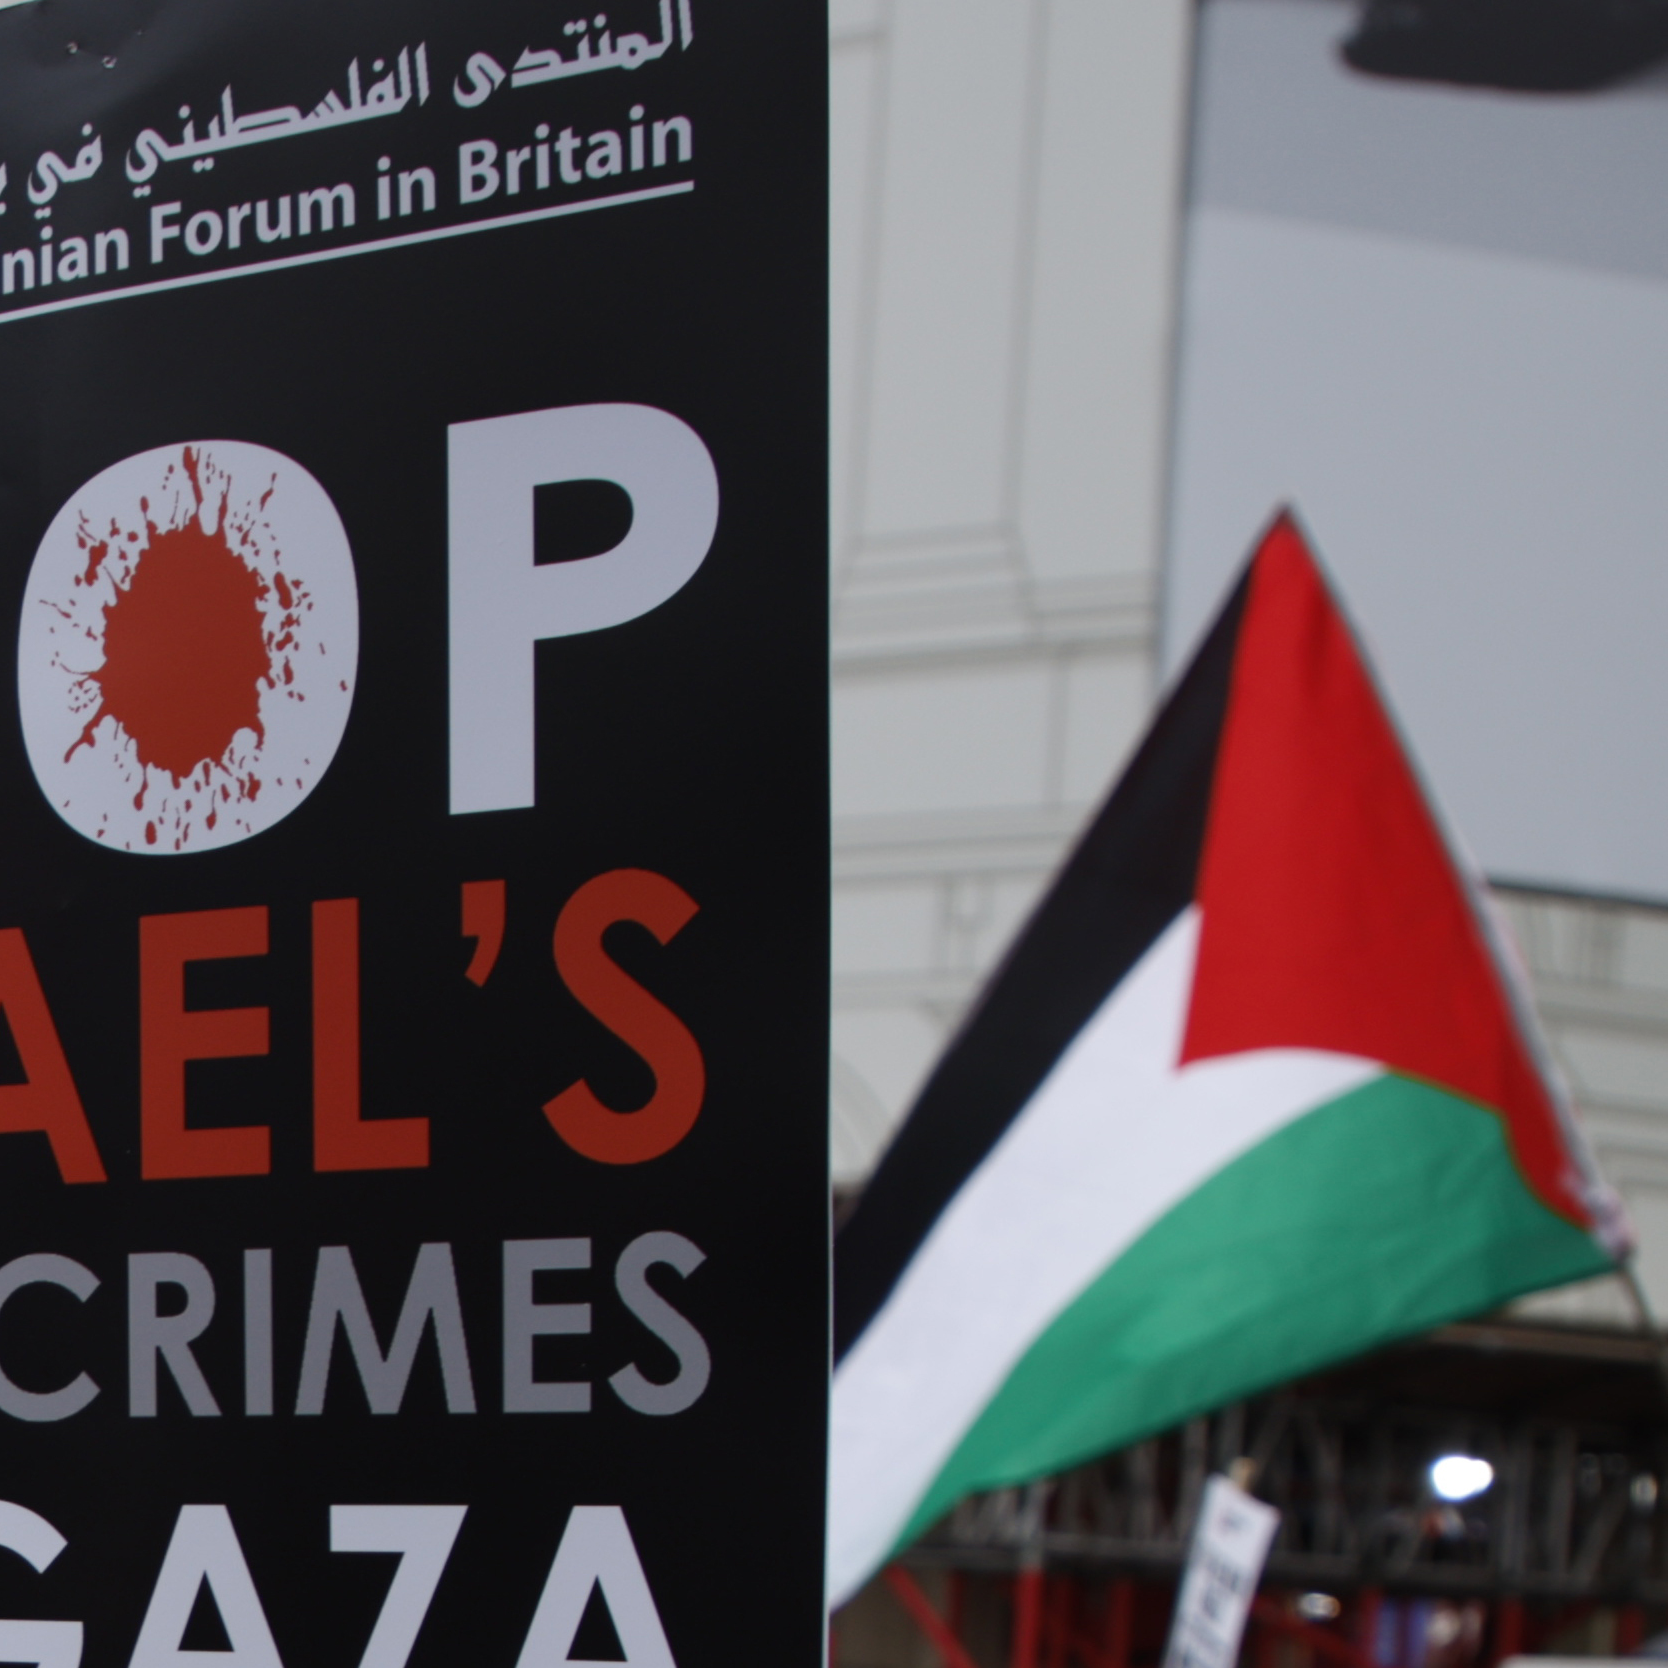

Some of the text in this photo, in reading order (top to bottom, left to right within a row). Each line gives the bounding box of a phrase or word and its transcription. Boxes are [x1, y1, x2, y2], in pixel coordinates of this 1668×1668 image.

[124, 42, 431, 198] الفلسطيني
[453, 0, 693, 110] المنتدى
[26, 122, 103, 220] في
[149, 182, 356, 264] Forum
[376, 155, 436, 221] in
[459, 103, 693, 206] Britain
